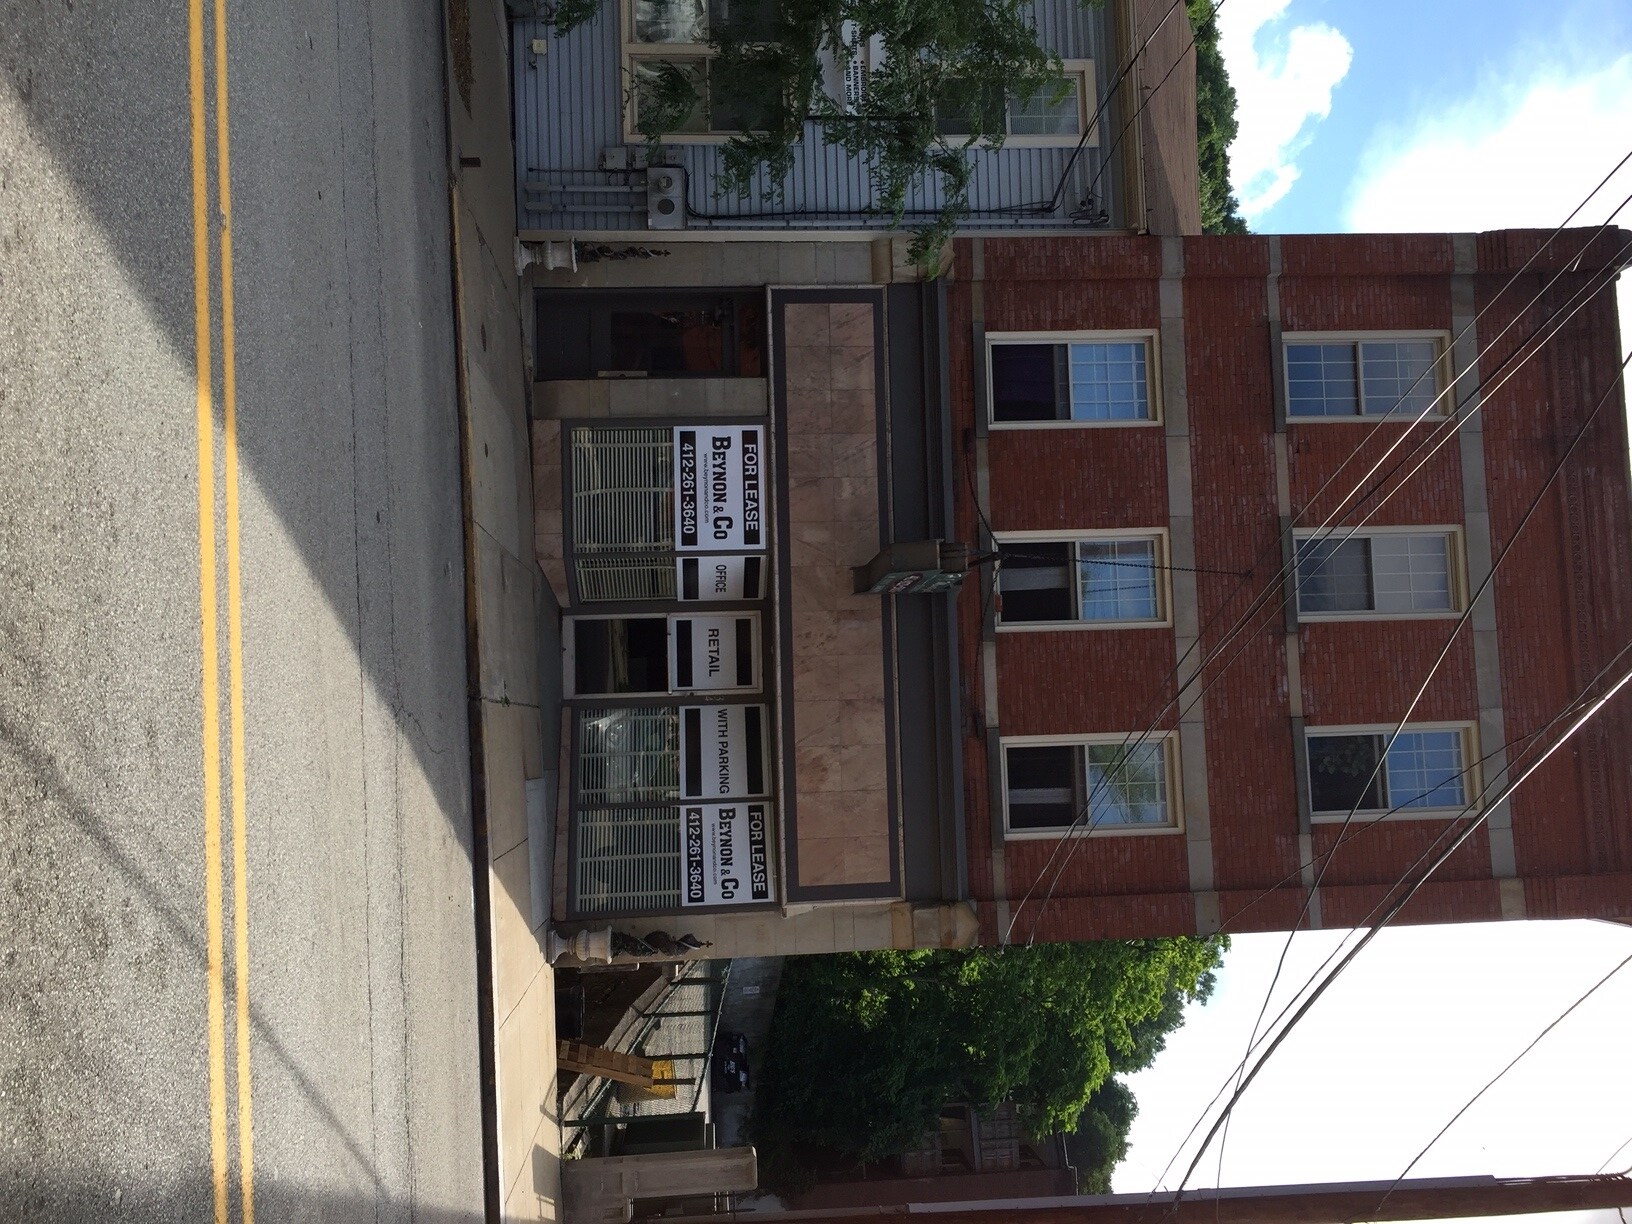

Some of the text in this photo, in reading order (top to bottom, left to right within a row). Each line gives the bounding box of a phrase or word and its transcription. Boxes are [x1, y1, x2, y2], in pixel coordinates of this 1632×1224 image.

[683, 443, 695, 533] 412-261-3640
[744, 444, 758, 530] FOR LEASE
[716, 565, 727, 592] OFFICE
[708, 628, 719, 676] RETAIL
[718, 709, 730, 794] WITH PARKING
[689, 812, 702, 898] 412-261-3640
[750, 812, 765, 892] FOR LEASE
